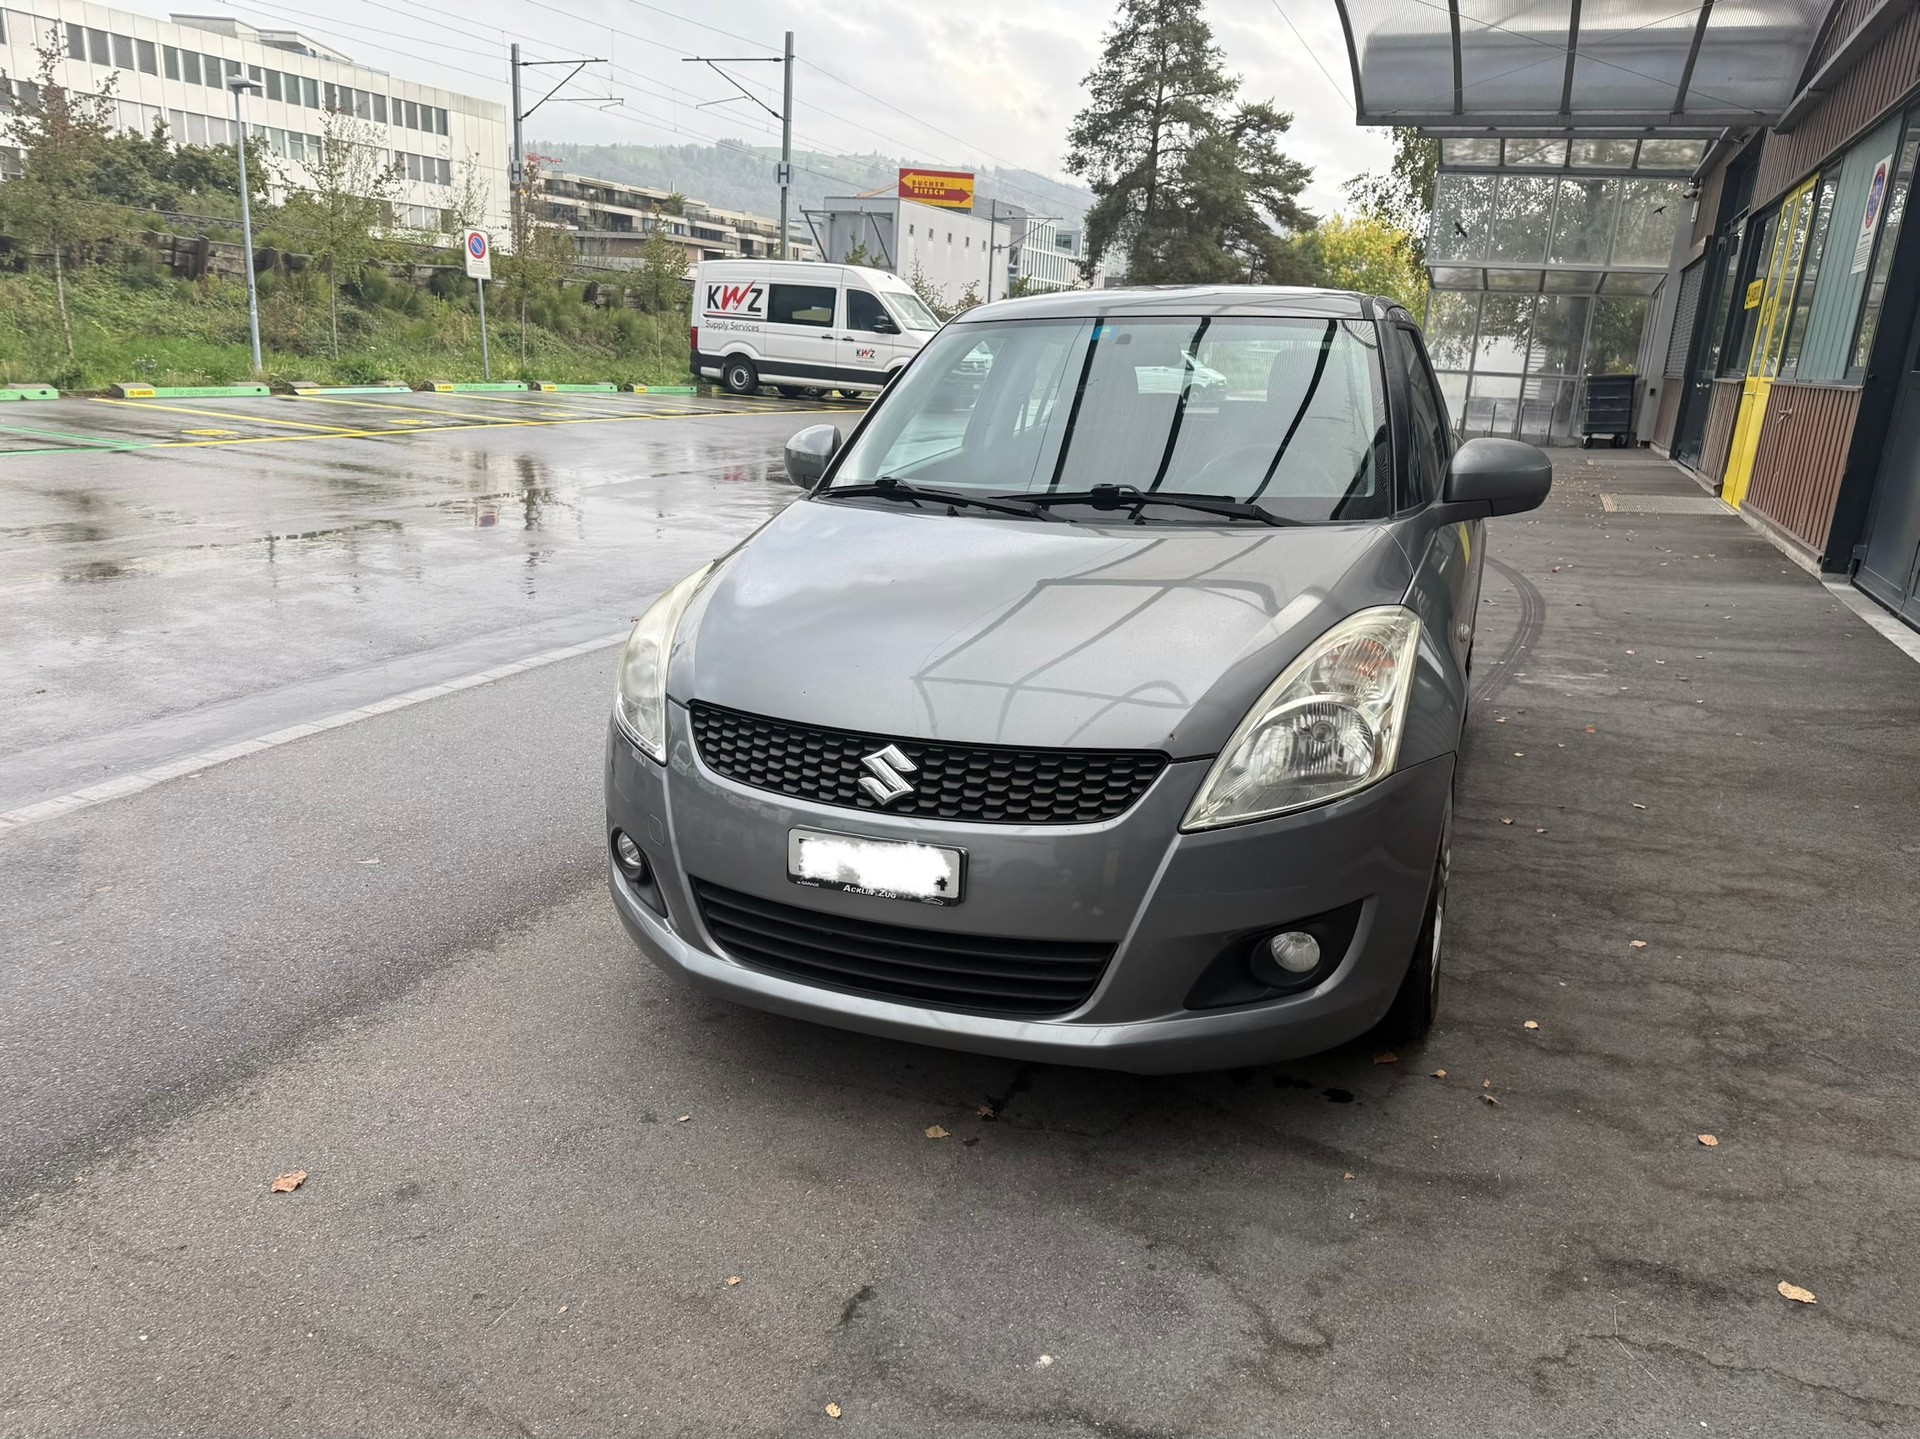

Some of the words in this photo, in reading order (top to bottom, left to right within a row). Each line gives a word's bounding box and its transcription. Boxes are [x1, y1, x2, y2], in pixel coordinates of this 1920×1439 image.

[777, 163, 789, 184] H
[707, 280, 763, 312] KWZ
[706, 320, 729, 331] Supply
[730, 321, 760, 332] Services
[856, 347, 876, 358] KWZ
